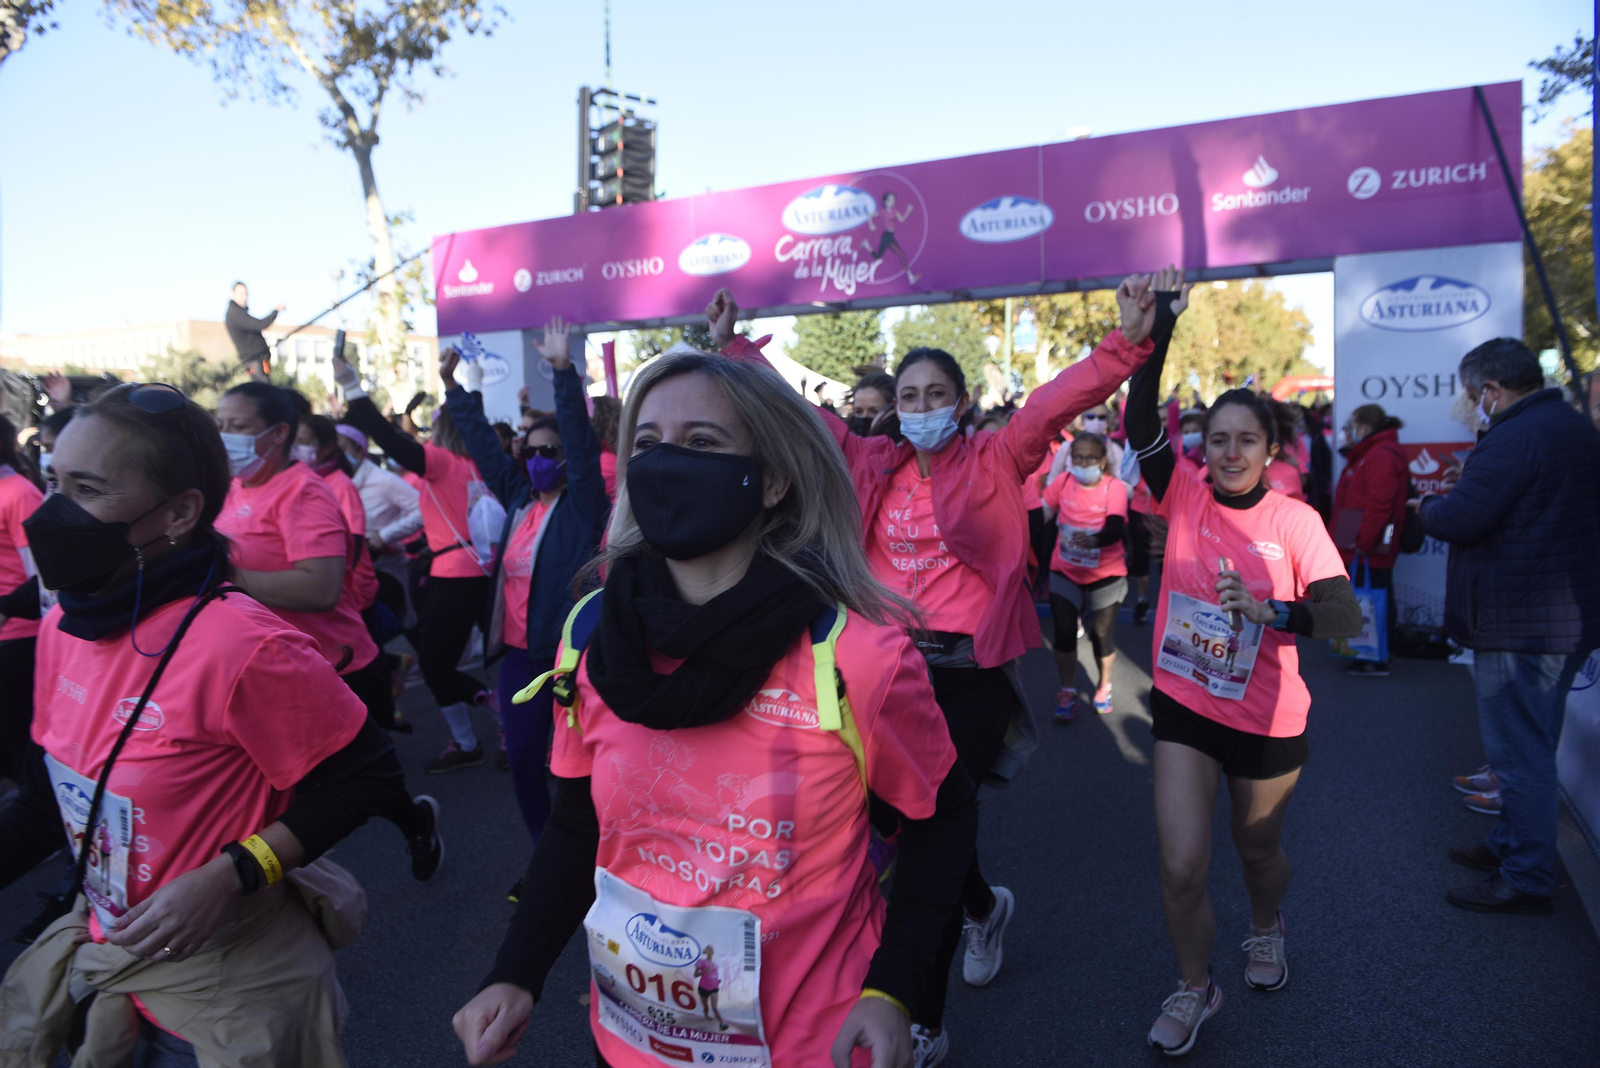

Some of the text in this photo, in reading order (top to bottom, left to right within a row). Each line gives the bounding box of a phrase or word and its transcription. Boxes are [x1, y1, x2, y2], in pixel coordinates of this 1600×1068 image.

[1391, 161, 1487, 190] ZURICH
[1084, 192, 1179, 223] OYSHO
[1211, 186, 1311, 212] Santander
[794, 203, 870, 225] ASTURIANA
[968, 215, 1046, 234] ASTURIANA
[688, 251, 746, 267] ASTURIANA
[775, 234, 852, 262] Carrera
[535, 267, 584, 287] ZURICH
[602, 256, 664, 280] OYSHO
[794, 252, 883, 295] de la Mujer
[443, 280, 495, 300] Santander
[1370, 299, 1479, 320] ASTURIANA
[1361, 373, 1456, 401] OYSH
[889, 509, 911, 520] WE
[889, 541, 948, 553] FOR A
[892, 557, 949, 571] REASON
[1195, 614, 1231, 635] ASTURIANA
[1192, 633, 1226, 659] 016
[1162, 657, 1190, 673] OYSHO
[749, 697, 817, 725] ASTURIANA
[728, 814, 795, 839] POR
[688, 835, 791, 870] TODAS
[636, 846, 782, 898] NOSOTRAS
[630, 920, 694, 961] ASTURIANA
[625, 963, 697, 1010] 016
[657, 1024, 671, 1036] DE
[672, 1027, 688, 1039] LA
[689, 1029, 730, 1044] MUJER
[719, 1055, 758, 1065] ZURICH
